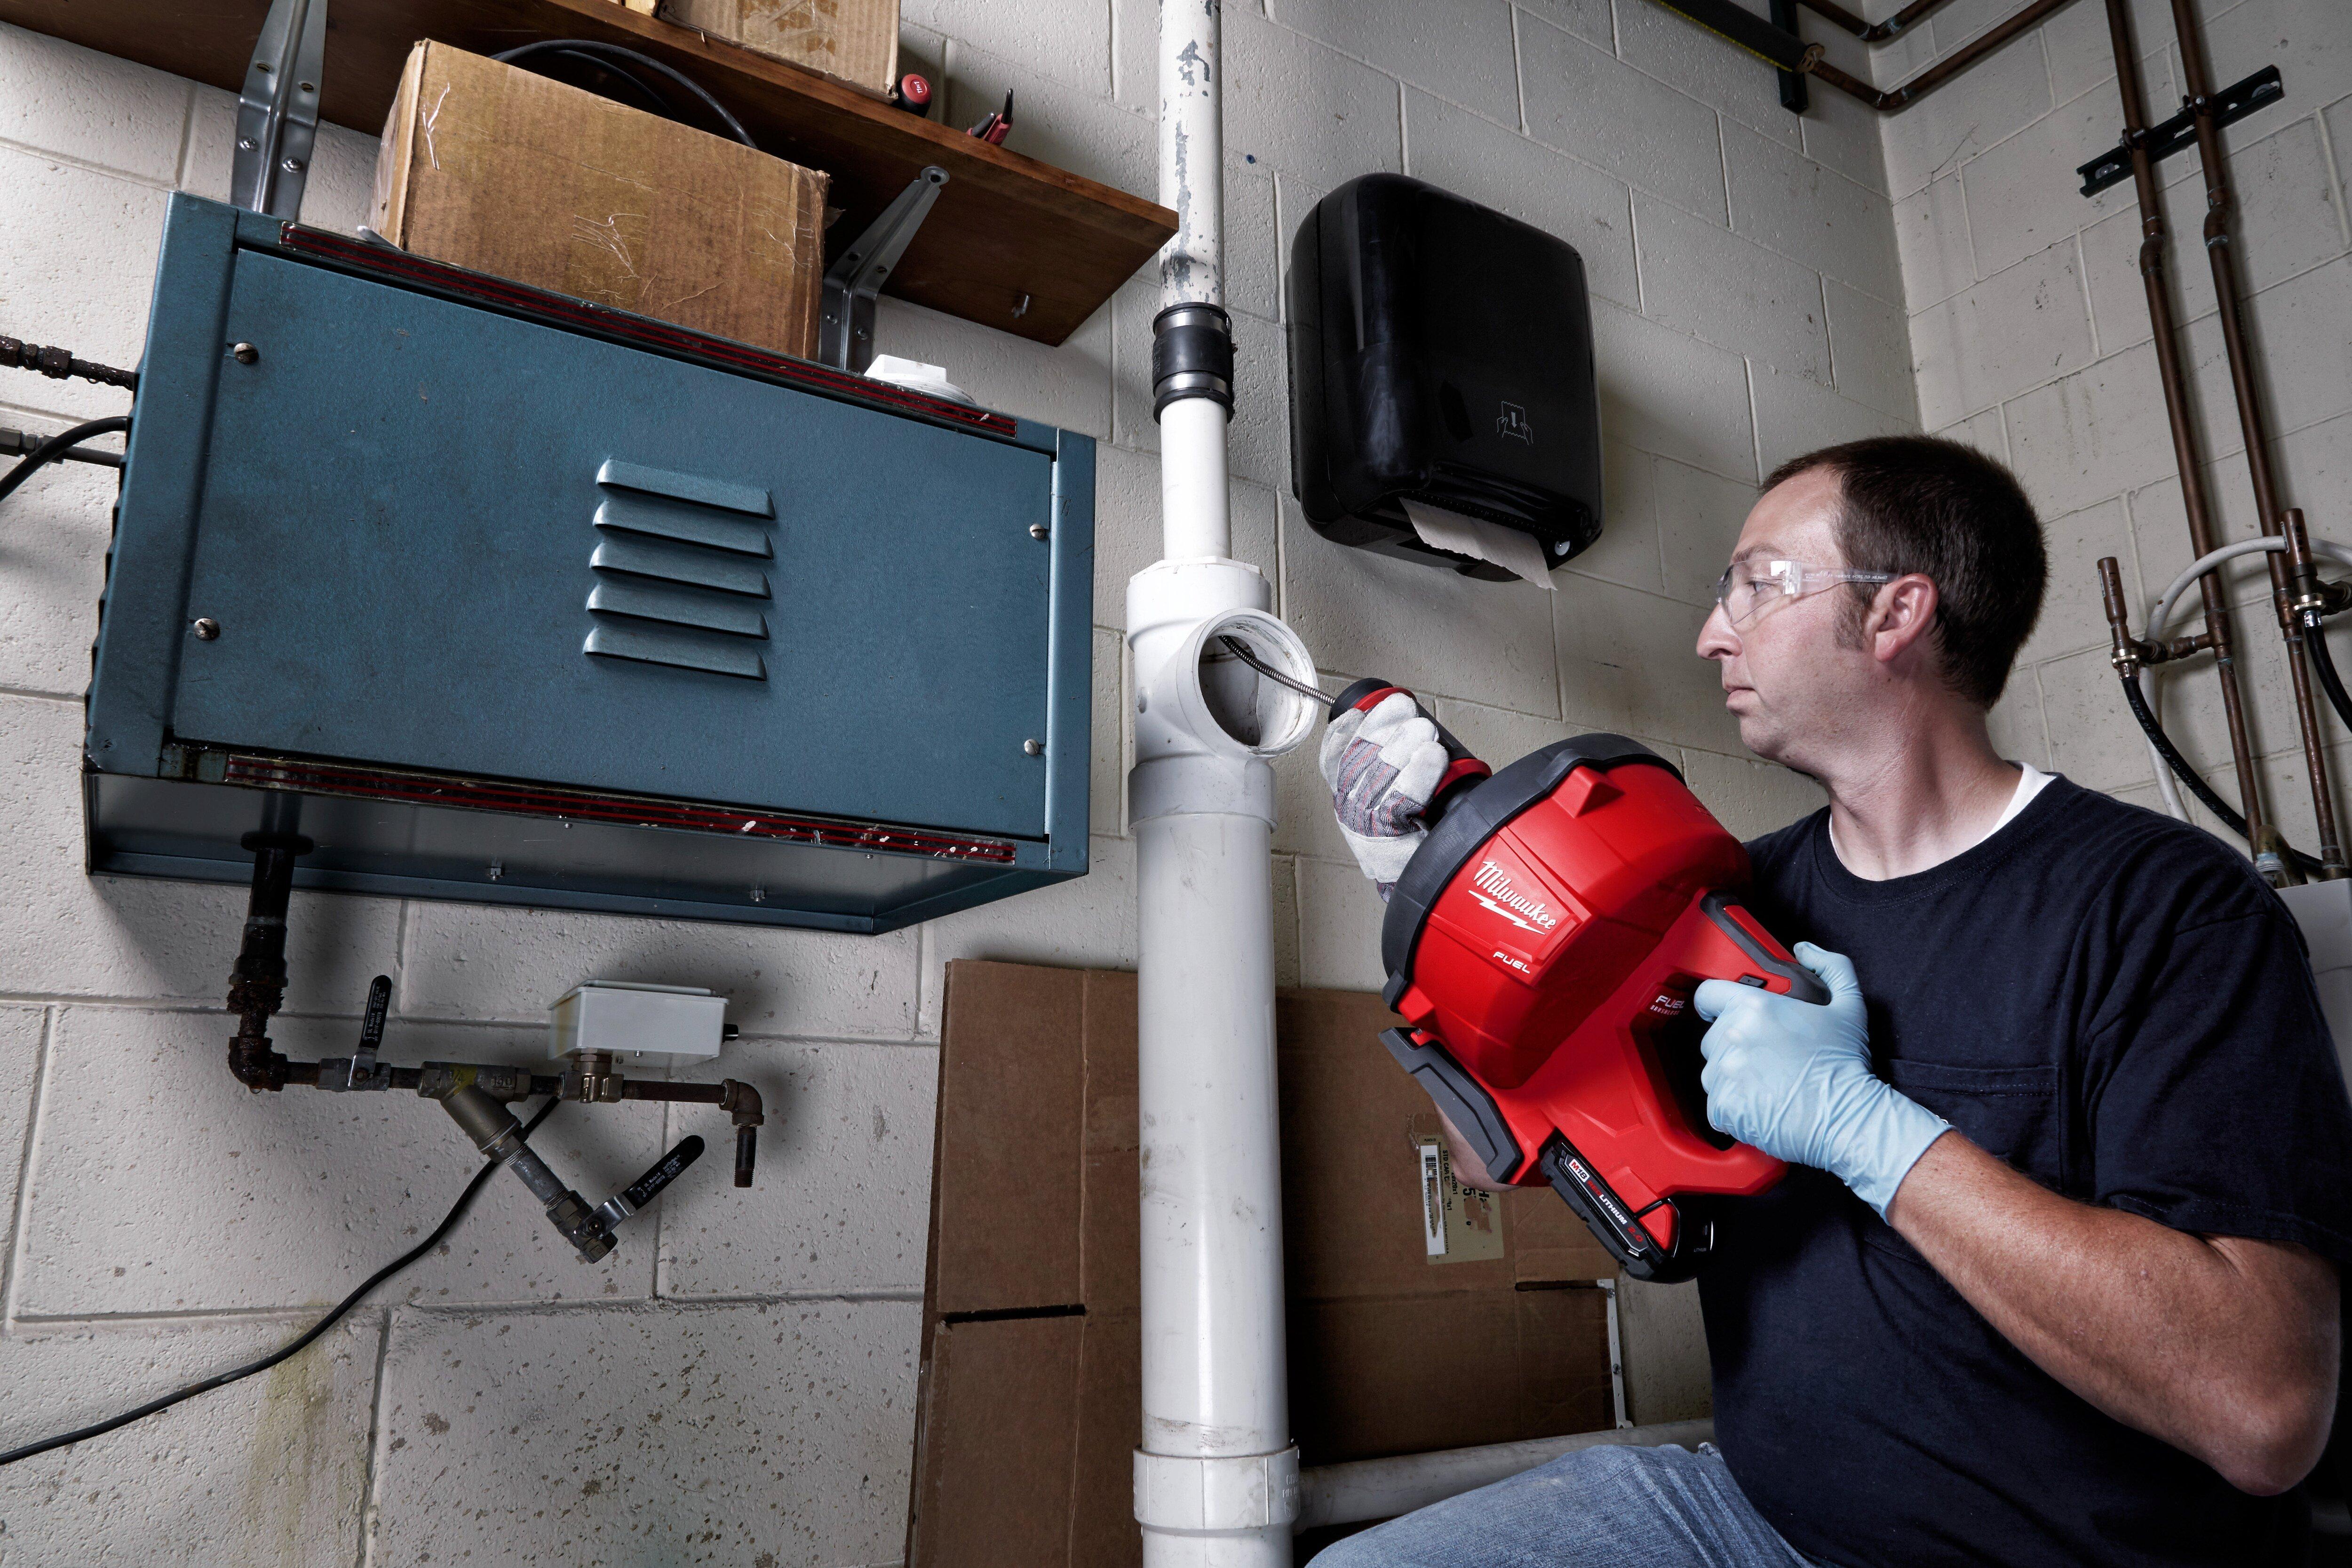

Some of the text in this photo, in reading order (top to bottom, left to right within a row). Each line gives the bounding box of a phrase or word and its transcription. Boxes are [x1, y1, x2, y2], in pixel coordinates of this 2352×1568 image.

[1473, 861, 1556, 930] Milwaukee
[1493, 951, 1531, 974] FUEL
[1655, 995, 1685, 1009] FUEL
[1571, 1162, 1588, 1179] M18
